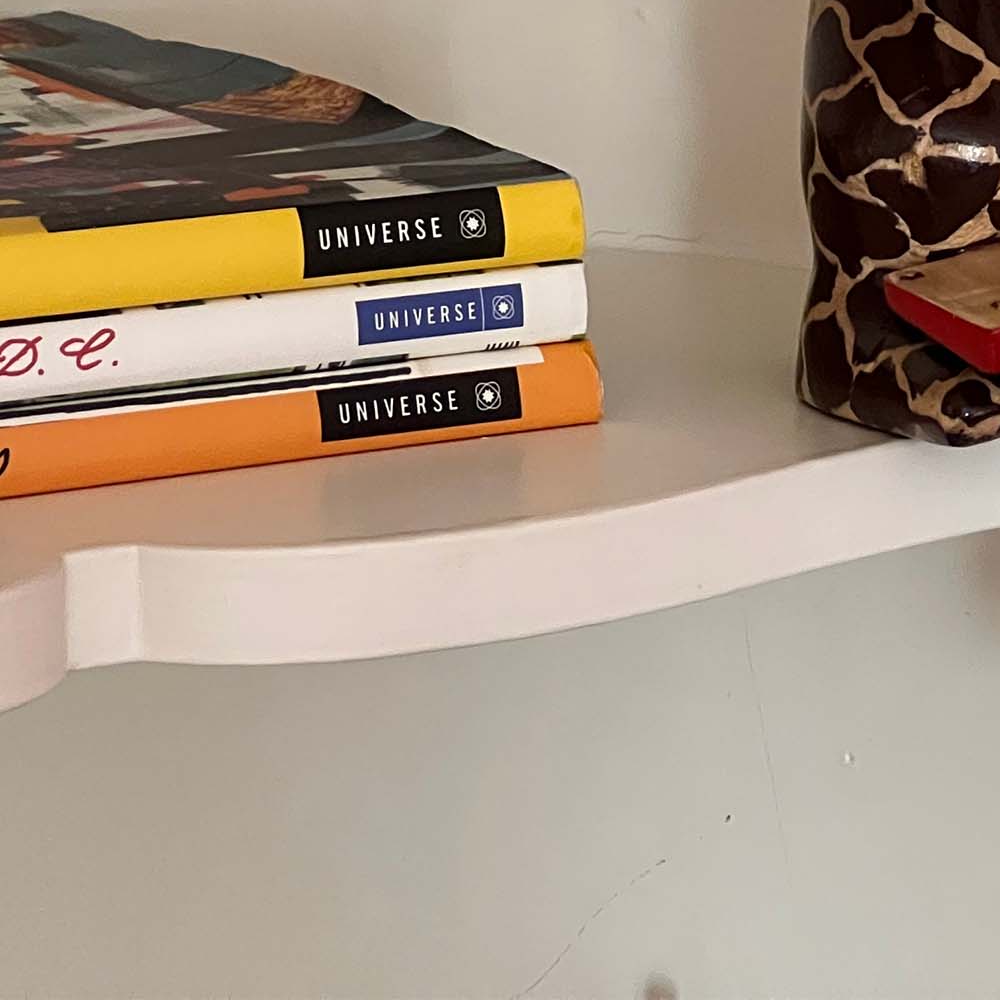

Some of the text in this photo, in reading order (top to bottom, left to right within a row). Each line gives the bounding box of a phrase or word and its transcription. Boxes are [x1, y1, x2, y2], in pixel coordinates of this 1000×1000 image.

[318, 216, 443, 250] UNIVERSE
[374, 302, 477, 331] UNIVERSE
[338, 390, 459, 424] UNIVERSE
